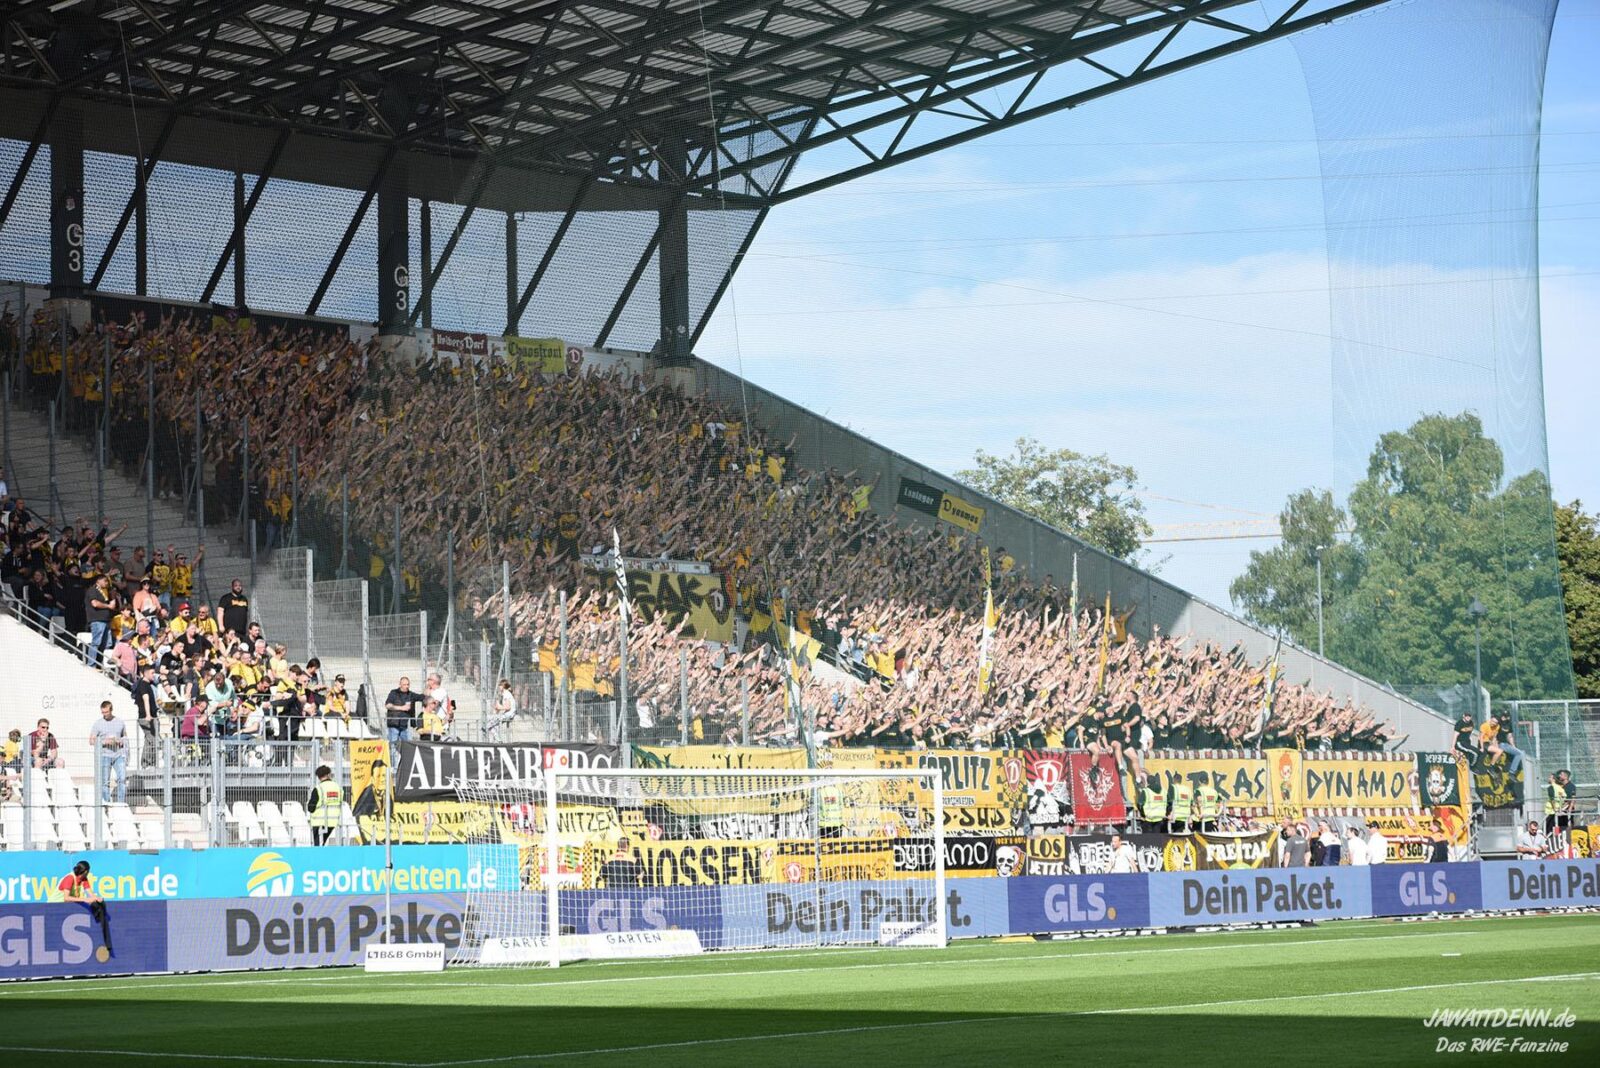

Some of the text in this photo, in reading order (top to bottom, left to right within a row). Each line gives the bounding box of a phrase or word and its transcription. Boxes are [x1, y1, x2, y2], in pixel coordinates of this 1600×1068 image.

[1306, 768, 1406, 800] DYNAMO
[633, 845, 762, 887] NOSSEN
[1030, 838, 1061, 858] LOS
[1206, 840, 1271, 862] FREITAL
[1406, 843, 1423, 857] SGD
[302, 861, 498, 897] sportwetten.de
[1183, 874, 1343, 916] Dein Paket.
[1508, 863, 1562, 900] Dein
[226, 901, 337, 957] Dein
[766, 888, 850, 935] Dein
[406, 949, 442, 959] GmbH
